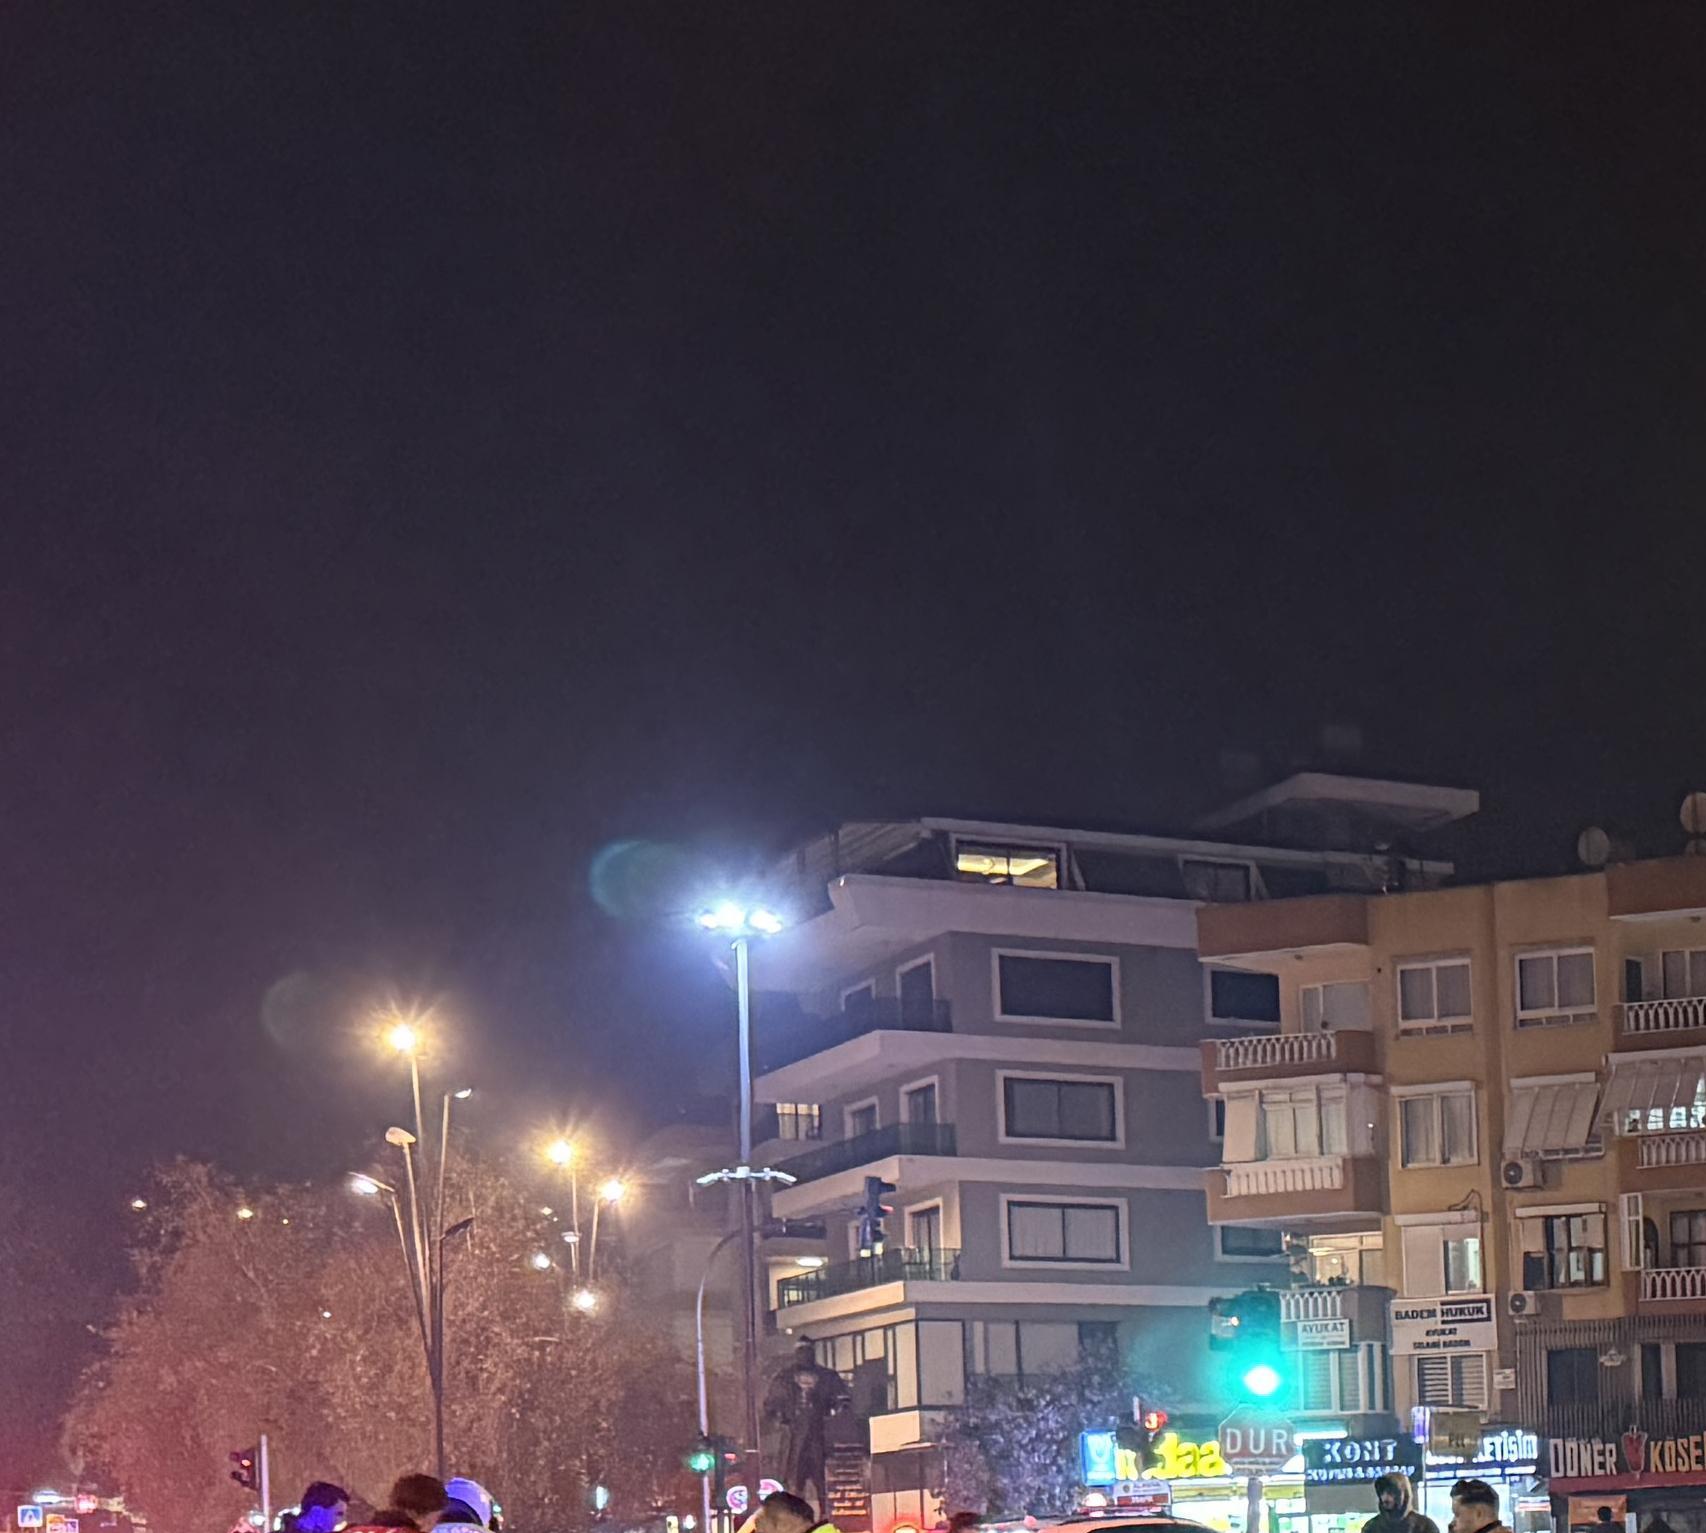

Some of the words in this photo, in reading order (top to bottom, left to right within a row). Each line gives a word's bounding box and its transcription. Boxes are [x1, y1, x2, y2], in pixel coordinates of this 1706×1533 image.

[1440, 1304, 1484, 1318] HUKUK
[1226, 1427, 1288, 1455] DUR
[1324, 1439, 1397, 1463] KONT
[1550, 1436, 1617, 1478] DÖNER
